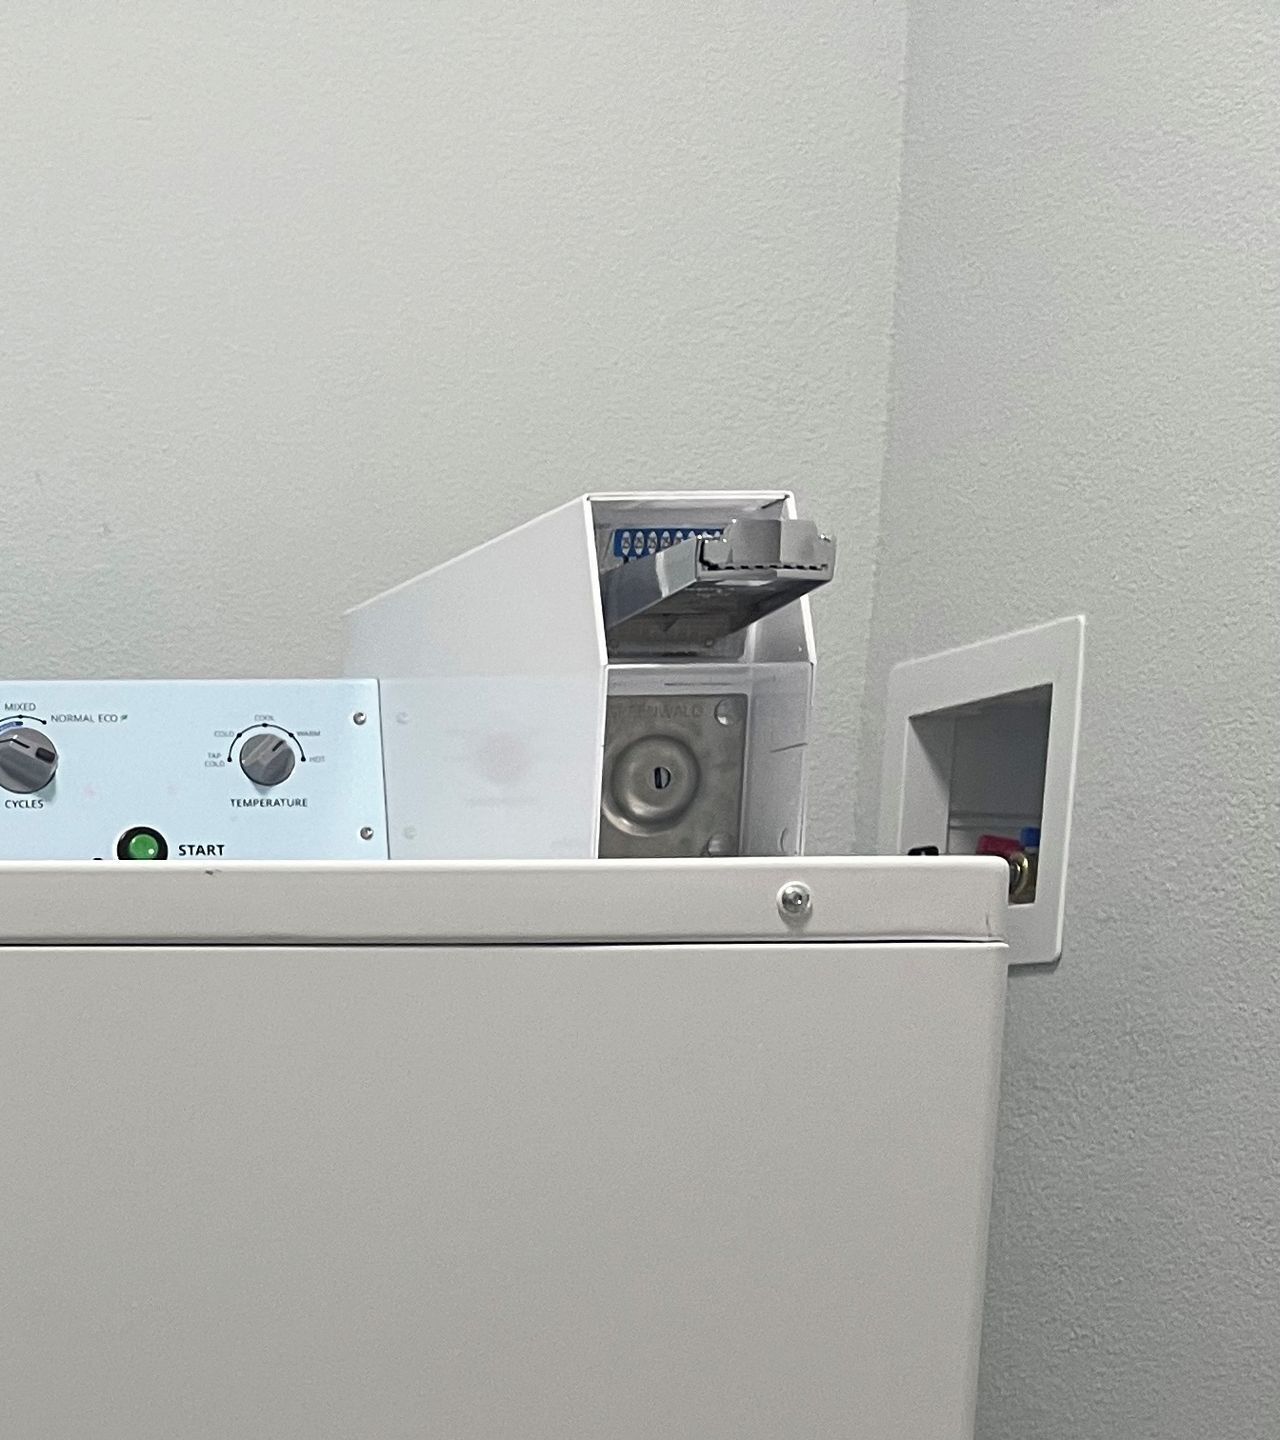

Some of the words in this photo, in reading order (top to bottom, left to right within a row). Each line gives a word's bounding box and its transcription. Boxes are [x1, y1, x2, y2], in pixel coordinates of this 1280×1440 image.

[4, 703, 36, 711] MIXED
[98, 714, 119, 722] ECO
[5, 800, 44, 809] CYCLES
[230, 798, 308, 807] TEMPERATURE
[178, 844, 225, 856] START
